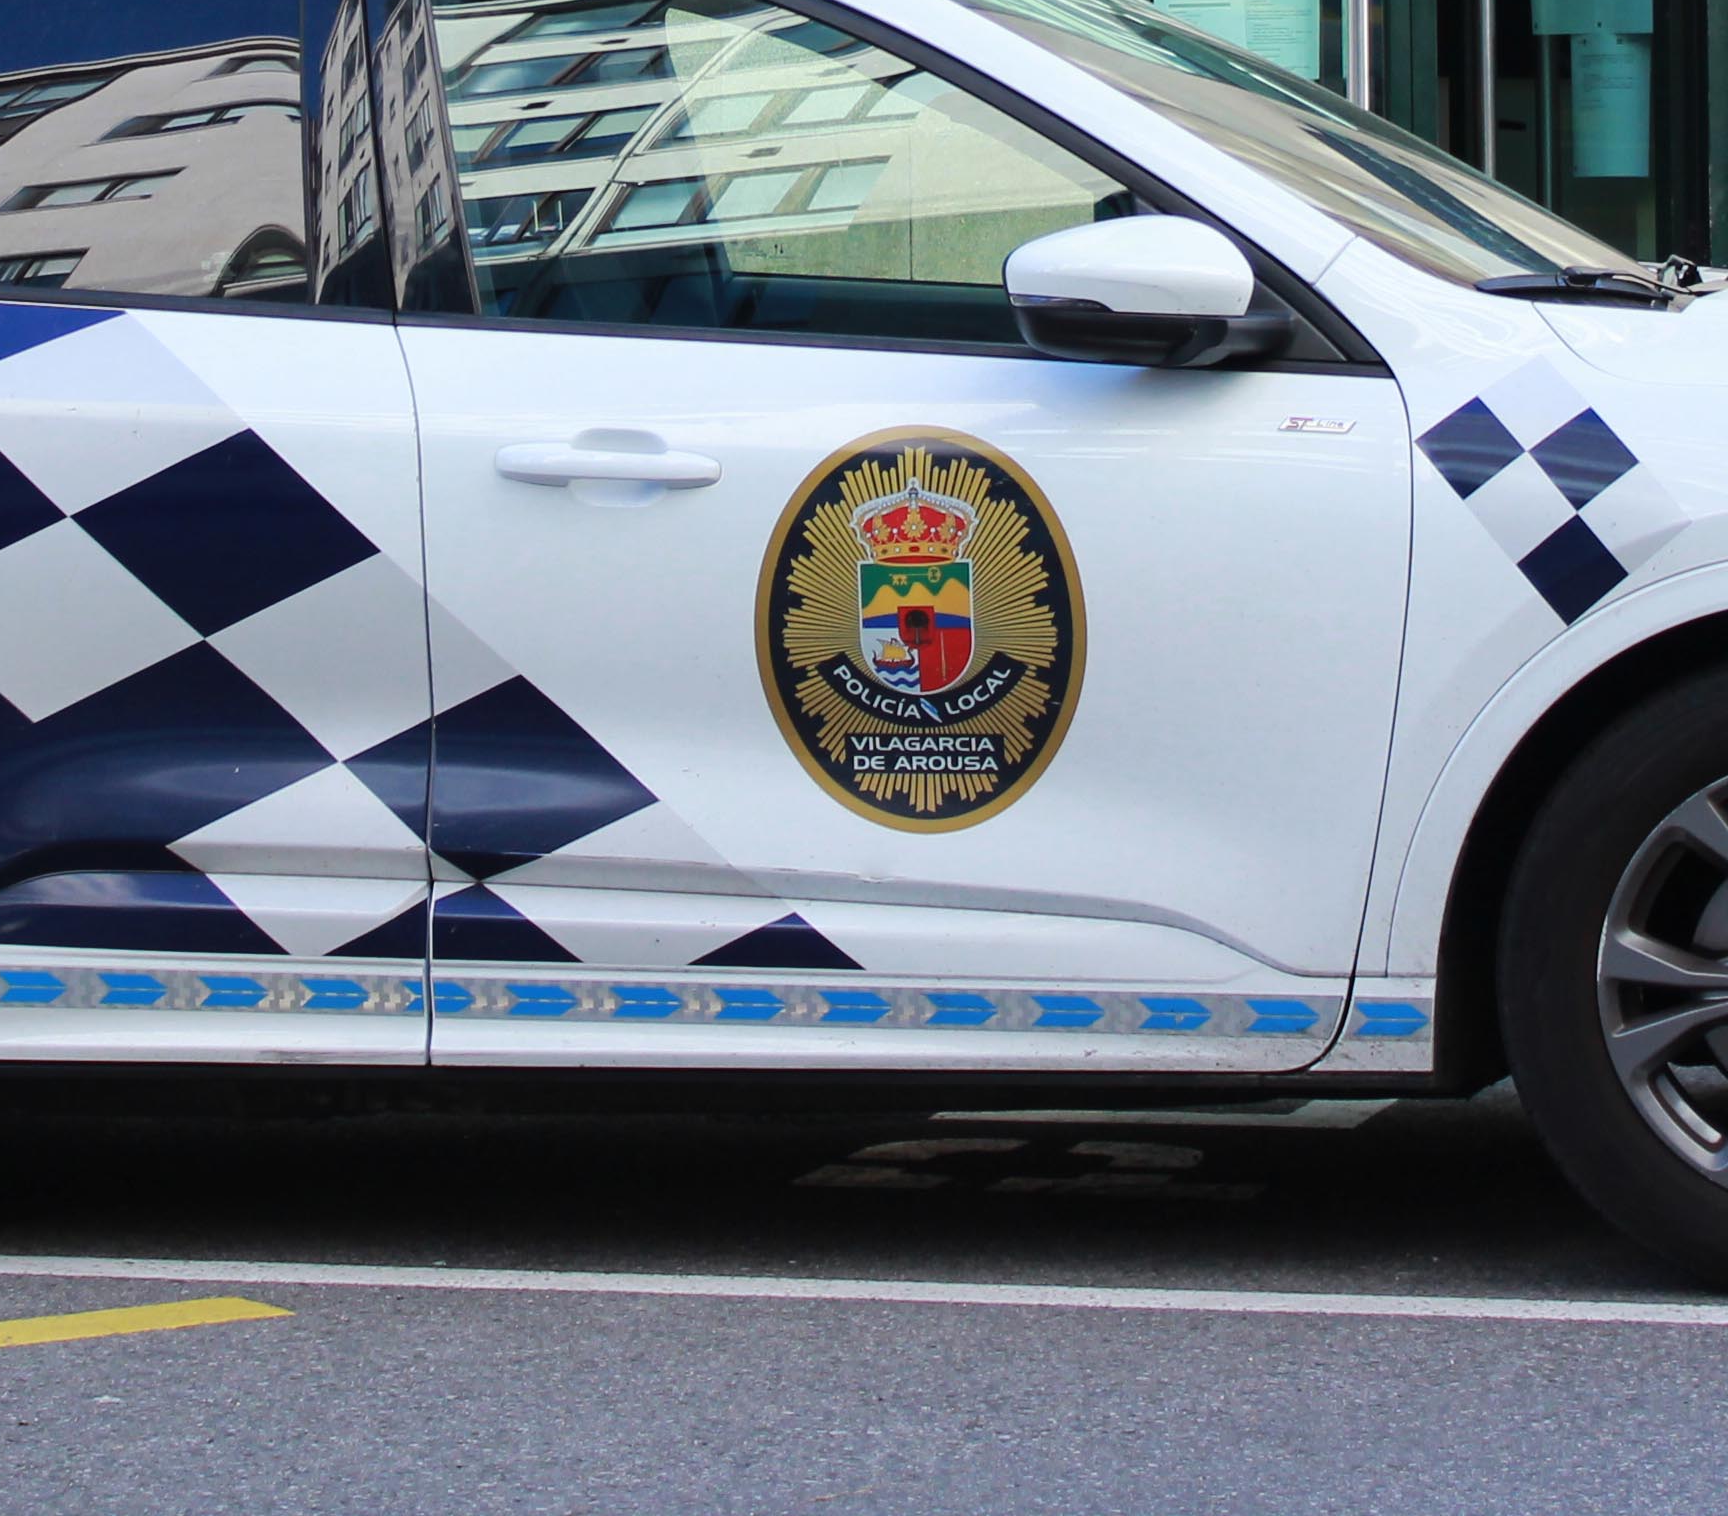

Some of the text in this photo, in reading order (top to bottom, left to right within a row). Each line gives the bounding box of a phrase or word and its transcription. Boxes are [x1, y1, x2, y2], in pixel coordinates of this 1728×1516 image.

[833, 665, 1012, 719] POLICÍA LOCAL
[851, 736, 995, 752] VILAGARCIA
[853, 756, 999, 772] DE AROUSA
